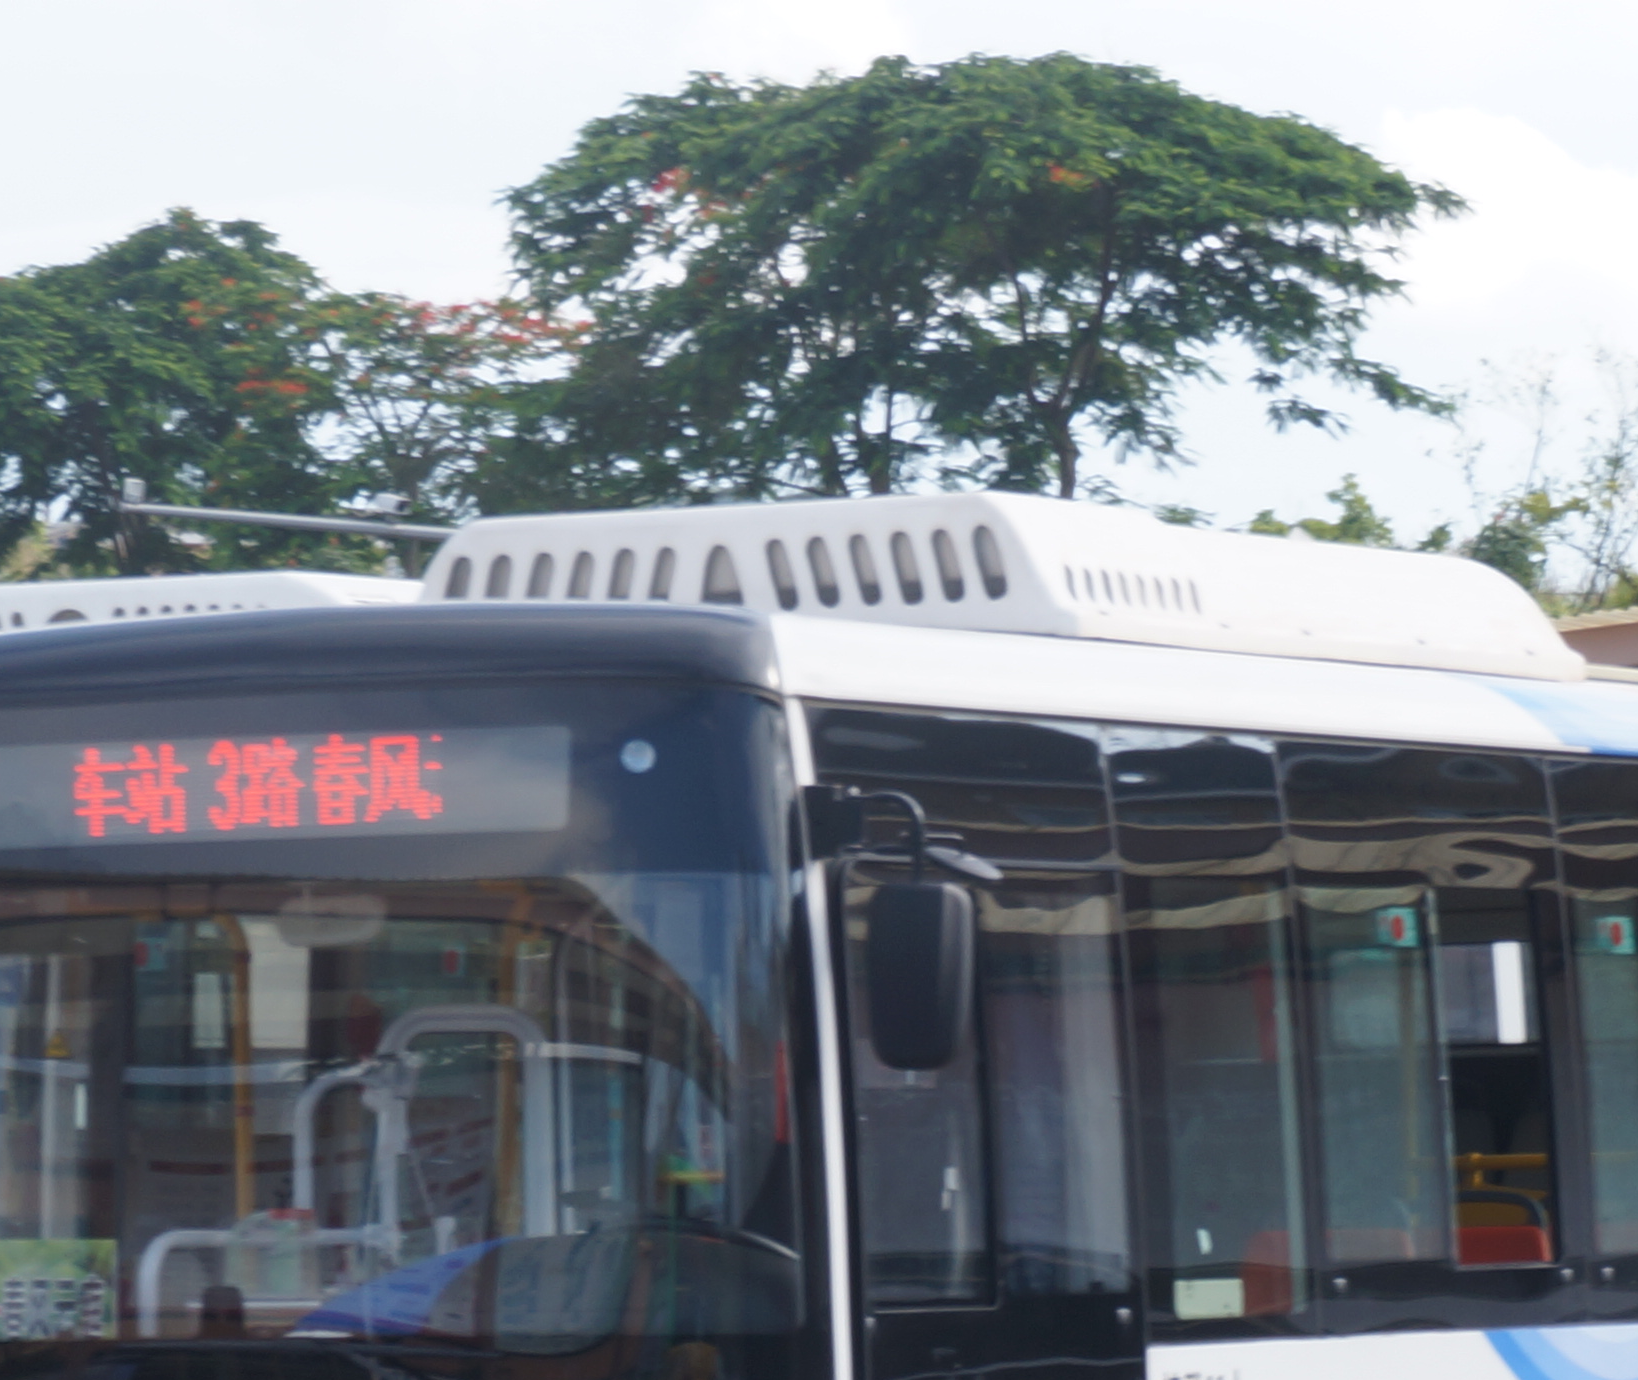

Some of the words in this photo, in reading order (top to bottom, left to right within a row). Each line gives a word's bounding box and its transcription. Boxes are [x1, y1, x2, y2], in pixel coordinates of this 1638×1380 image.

[73, 746, 189, 837] 车站
[207, 739, 306, 831] 3路
[312, 733, 443, 824] 春风
